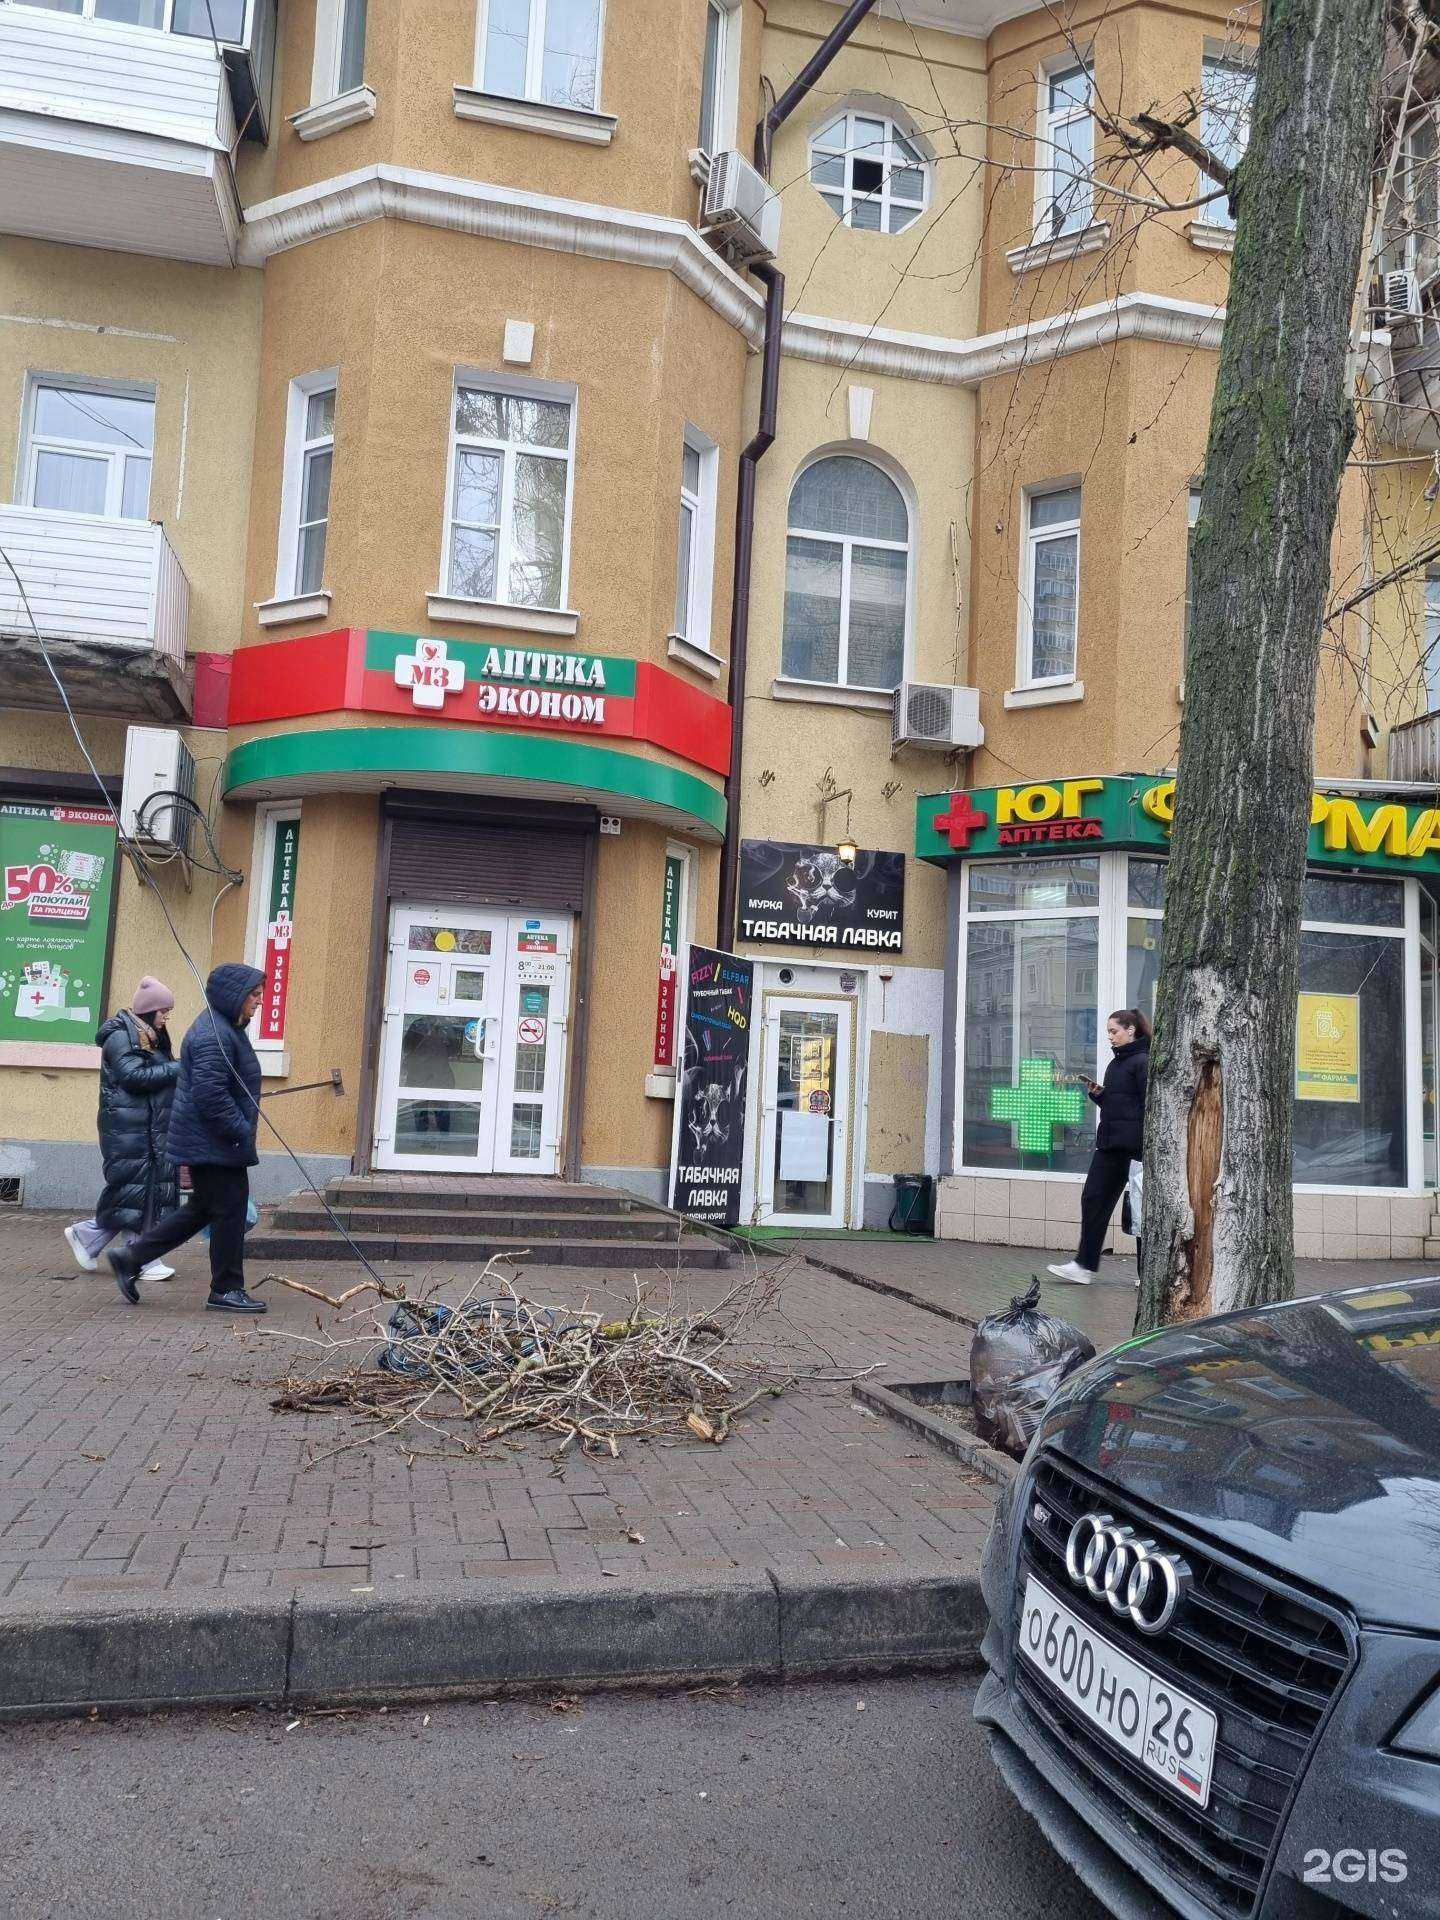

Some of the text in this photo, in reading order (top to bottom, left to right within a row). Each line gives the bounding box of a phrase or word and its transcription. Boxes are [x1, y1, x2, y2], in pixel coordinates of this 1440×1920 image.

[481, 648, 606, 688] АПТЕКА
[478, 684, 606, 724] ЭКОНОМ
[0, 805, 47, 817] АПТЕКА
[68, 811, 114, 822] ЭКОНОМ
[996, 779, 1104, 824] ЮГ
[998, 823, 1104, 845] АПТЕКА
[280, 829, 294, 908] АПТЕКА
[6, 864, 73, 902] 50%
[32, 895, 84, 906] ПОКУПАЙ
[45, 906, 84, 916] ПОЛЦЕНЫ
[663, 865, 674, 941] АПТЕКА
[748, 899, 899, 920] МУРКА КУРИТ
[743, 920, 902, 948] ТАБАЧНАЯ ЛАВКА
[691, 963, 714, 985] FIZZY
[722, 969, 749, 985] ELFBAR
[269, 956, 283, 1032] ЭКОНОМ
[658, 986, 668, 1059] ЭКОНОМ
[727, 1005, 747, 1029] HQD
[1321, 1074, 1348, 1083] ФАРМА
[678, 1166, 740, 1184] ТАБАЧНАЯ
[687, 1189, 728, 1207] ЛАВКА
[707, 1212, 727, 1220] КУРИТ
[1151, 1692, 1194, 1759] 26
[1146, 1739, 1177, 1776] RUS
